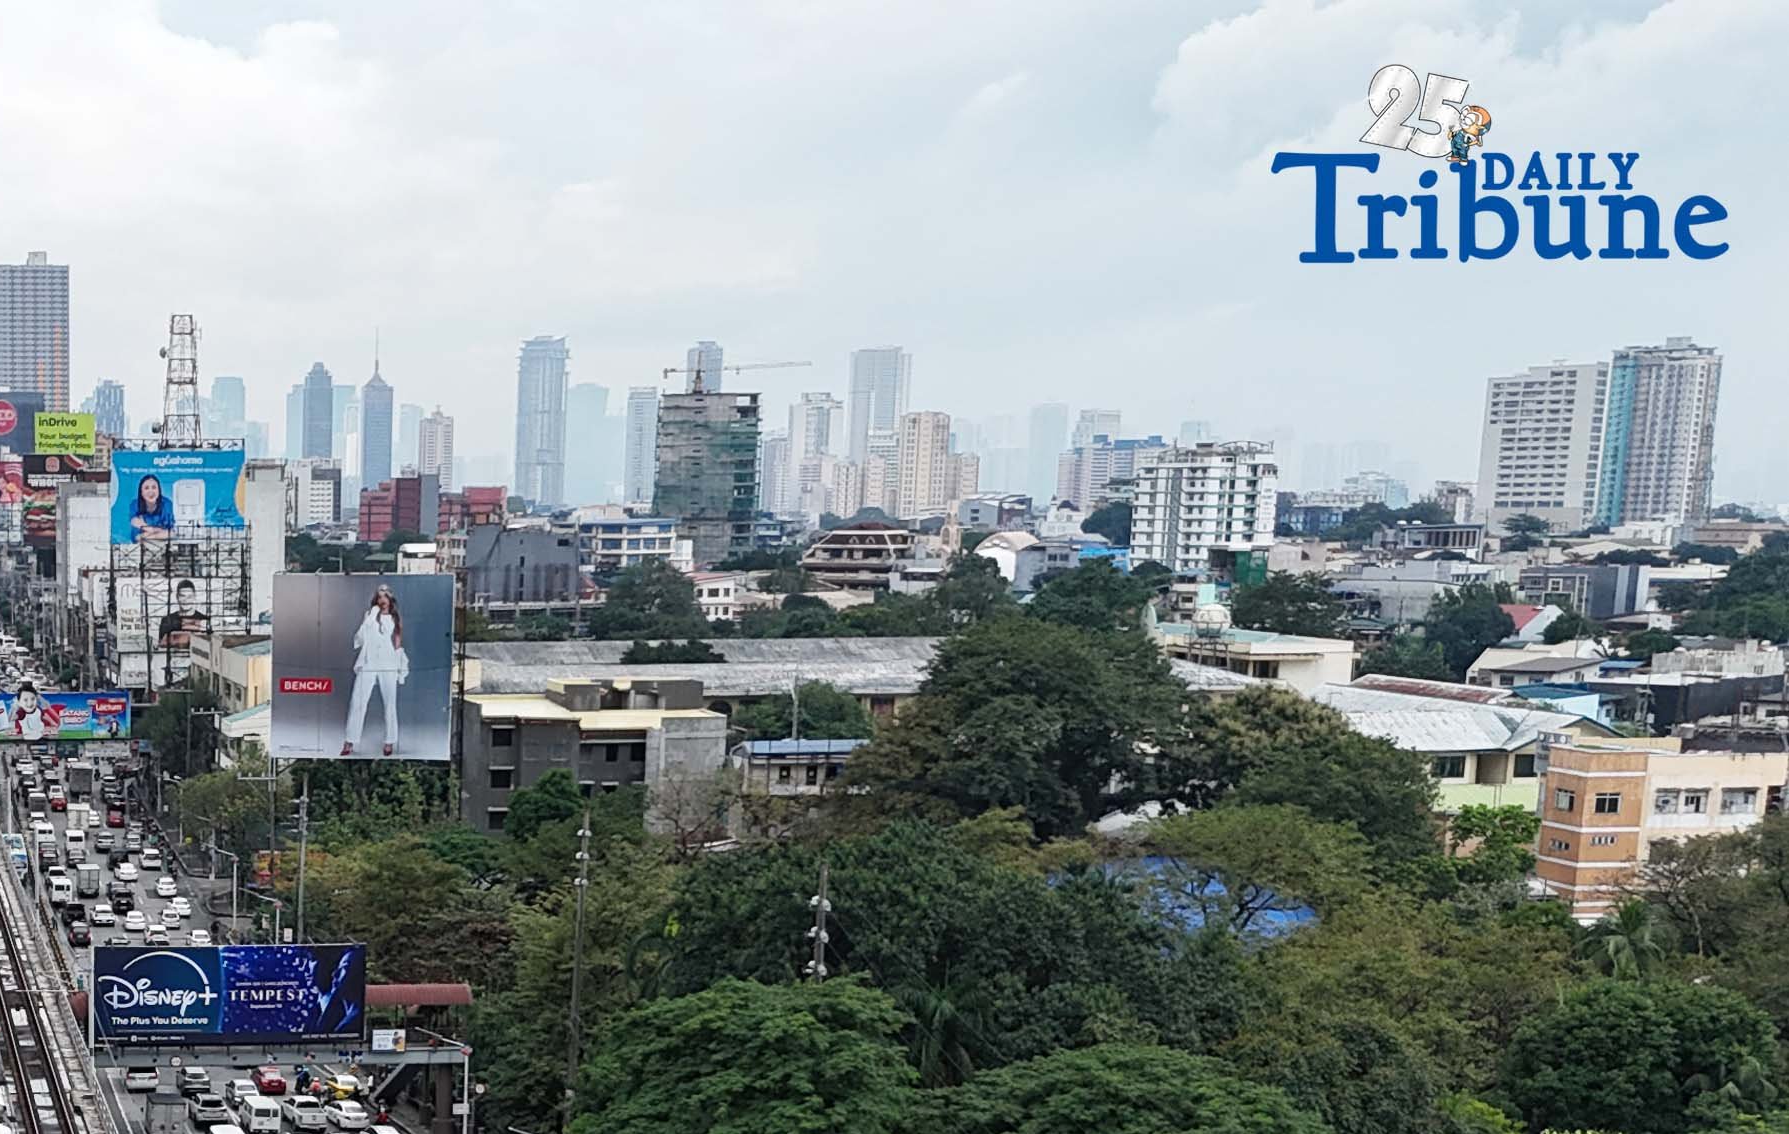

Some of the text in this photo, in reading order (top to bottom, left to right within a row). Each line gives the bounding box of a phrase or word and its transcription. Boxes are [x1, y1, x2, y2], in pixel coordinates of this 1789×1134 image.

[38, 417, 77, 428] inDrive
[58, 432, 87, 441] budget
[38, 441, 69, 450] friendly
[228, 989, 307, 1002] TEMPEST
[111, 1016, 209, 1025] The Plus You Deserve
